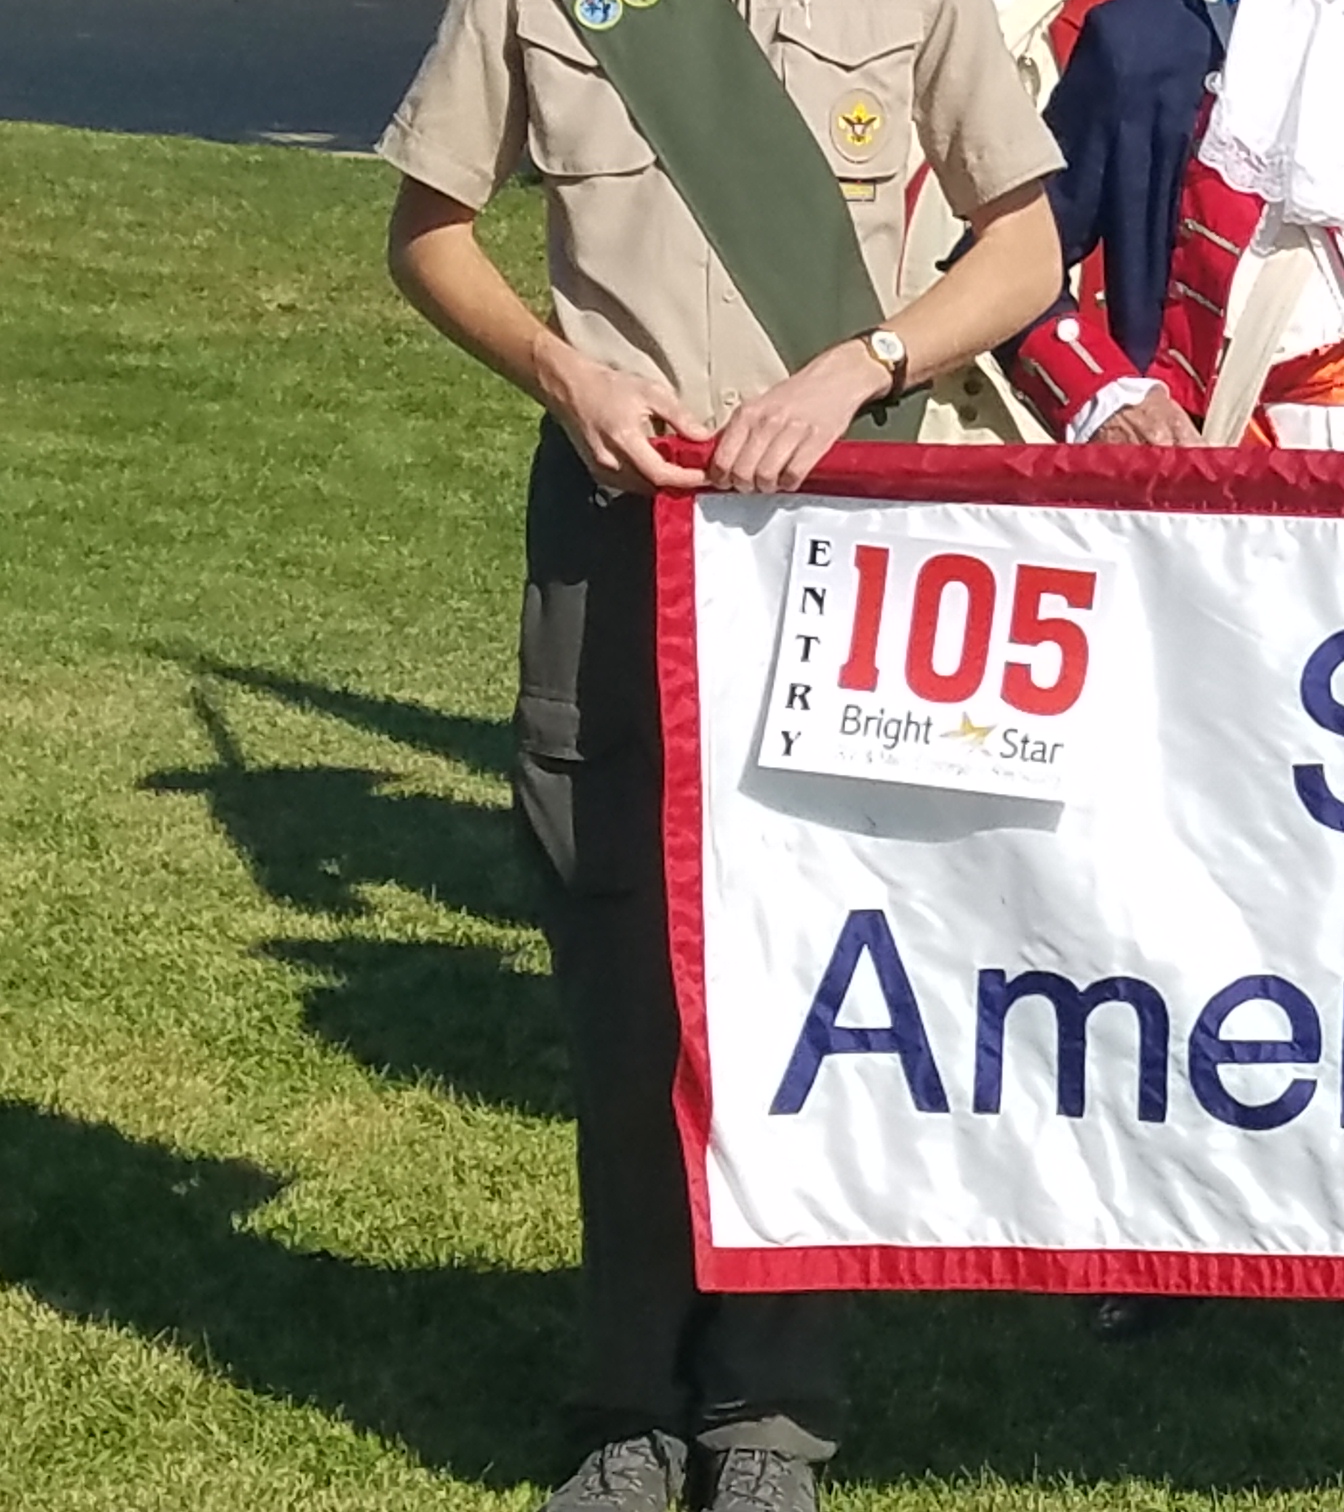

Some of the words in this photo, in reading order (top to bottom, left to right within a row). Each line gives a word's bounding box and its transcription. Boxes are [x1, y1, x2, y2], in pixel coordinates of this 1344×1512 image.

[780, 538, 832, 757] ENTRY
[838, 544, 1097, 716] 105
[840, 704, 933, 750] Bright
[1000, 728, 1064, 764] Star
